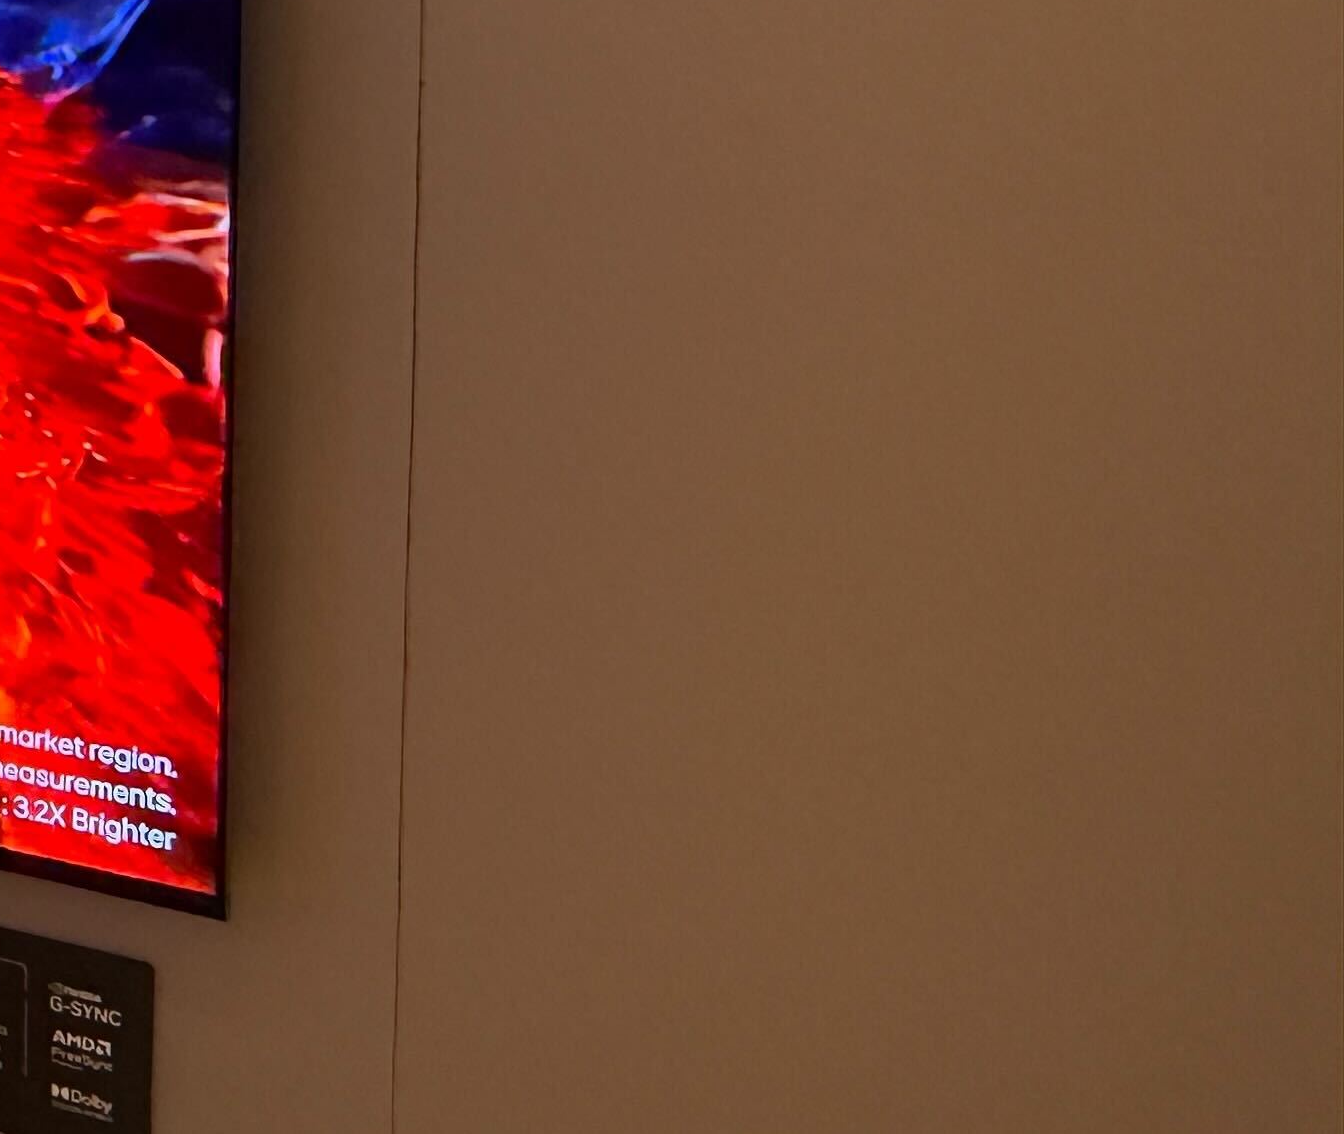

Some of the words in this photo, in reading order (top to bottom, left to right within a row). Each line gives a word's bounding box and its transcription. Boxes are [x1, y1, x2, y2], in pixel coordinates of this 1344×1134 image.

[88, 744, 178, 779] region.
[13, 796, 66, 828] 3.2X
[71, 806, 178, 851] Brighter
[49, 995, 123, 1027] G-SYNC
[52, 1029, 95, 1052] AMD
[70, 1088, 113, 1115] Dolby
